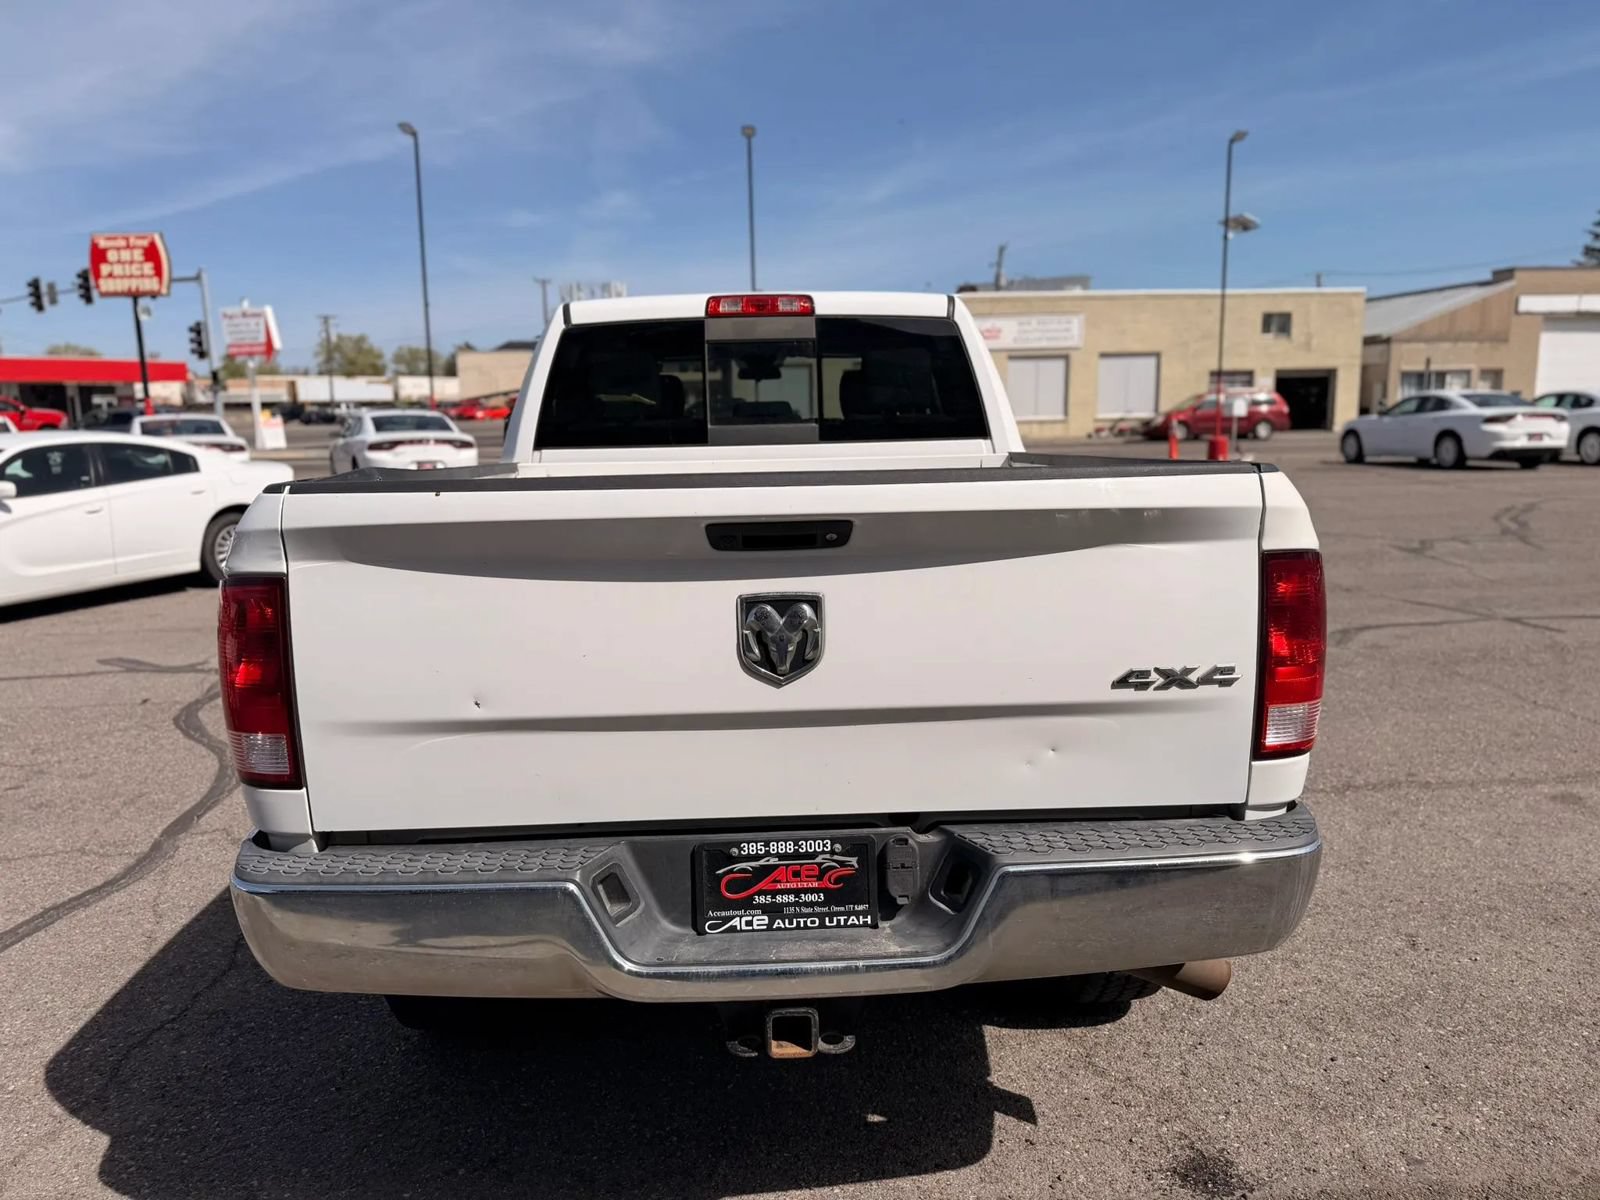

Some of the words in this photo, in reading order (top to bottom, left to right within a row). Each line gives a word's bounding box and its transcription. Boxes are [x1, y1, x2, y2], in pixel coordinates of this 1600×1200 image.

[740, 840, 831, 855] 385-888-3003
[752, 893, 824, 904] 385-888-3003
[707, 909, 762, 917] Aceautout.com
[773, 917, 819, 928] AUTO
[825, 915, 872, 926] UTAH
